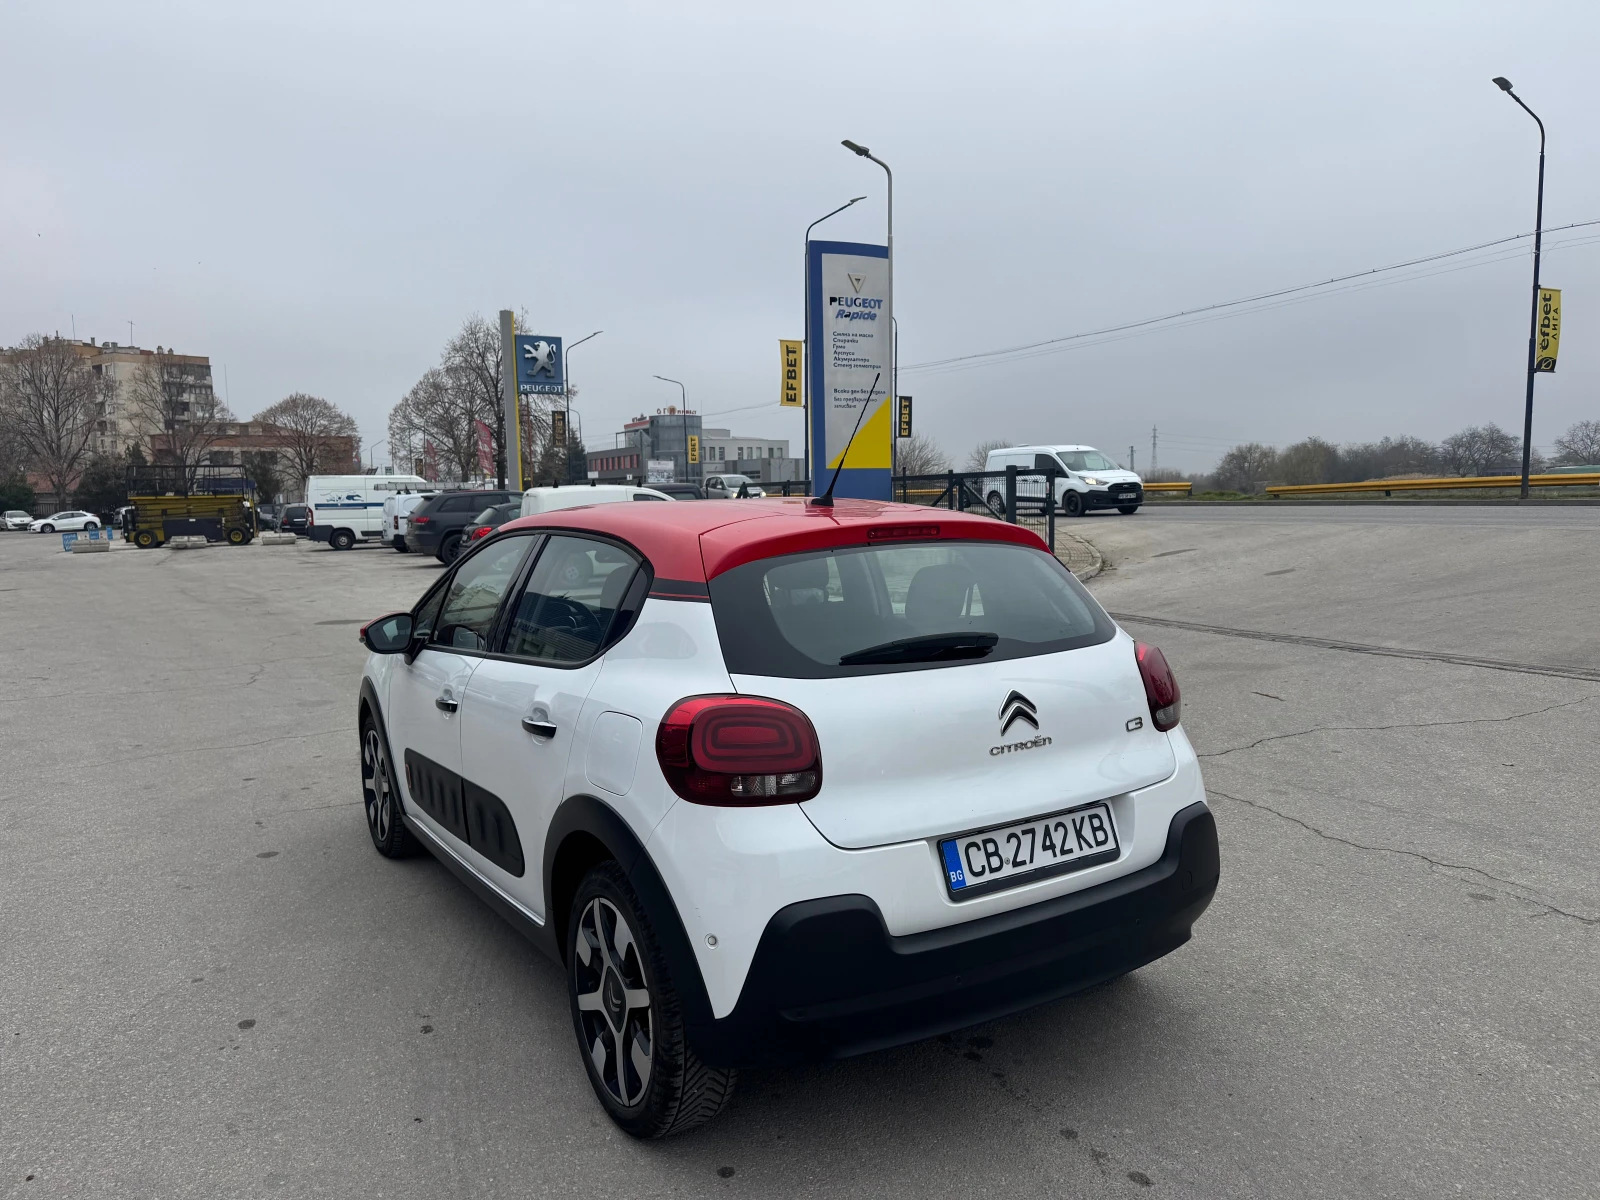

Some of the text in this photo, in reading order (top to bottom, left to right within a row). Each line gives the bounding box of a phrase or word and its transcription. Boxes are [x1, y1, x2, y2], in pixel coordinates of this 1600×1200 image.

[829, 296, 883, 310] PEUGEOT
[835, 309, 877, 321] Rapide
[1541, 293, 1552, 350] efbet
[1551, 307, 1559, 340] ЛИГА
[786, 344, 797, 402] EFBET
[520, 384, 563, 393] PEUGEOT
[1125, 717, 1143, 733] C3
[950, 871, 964, 883] BG
